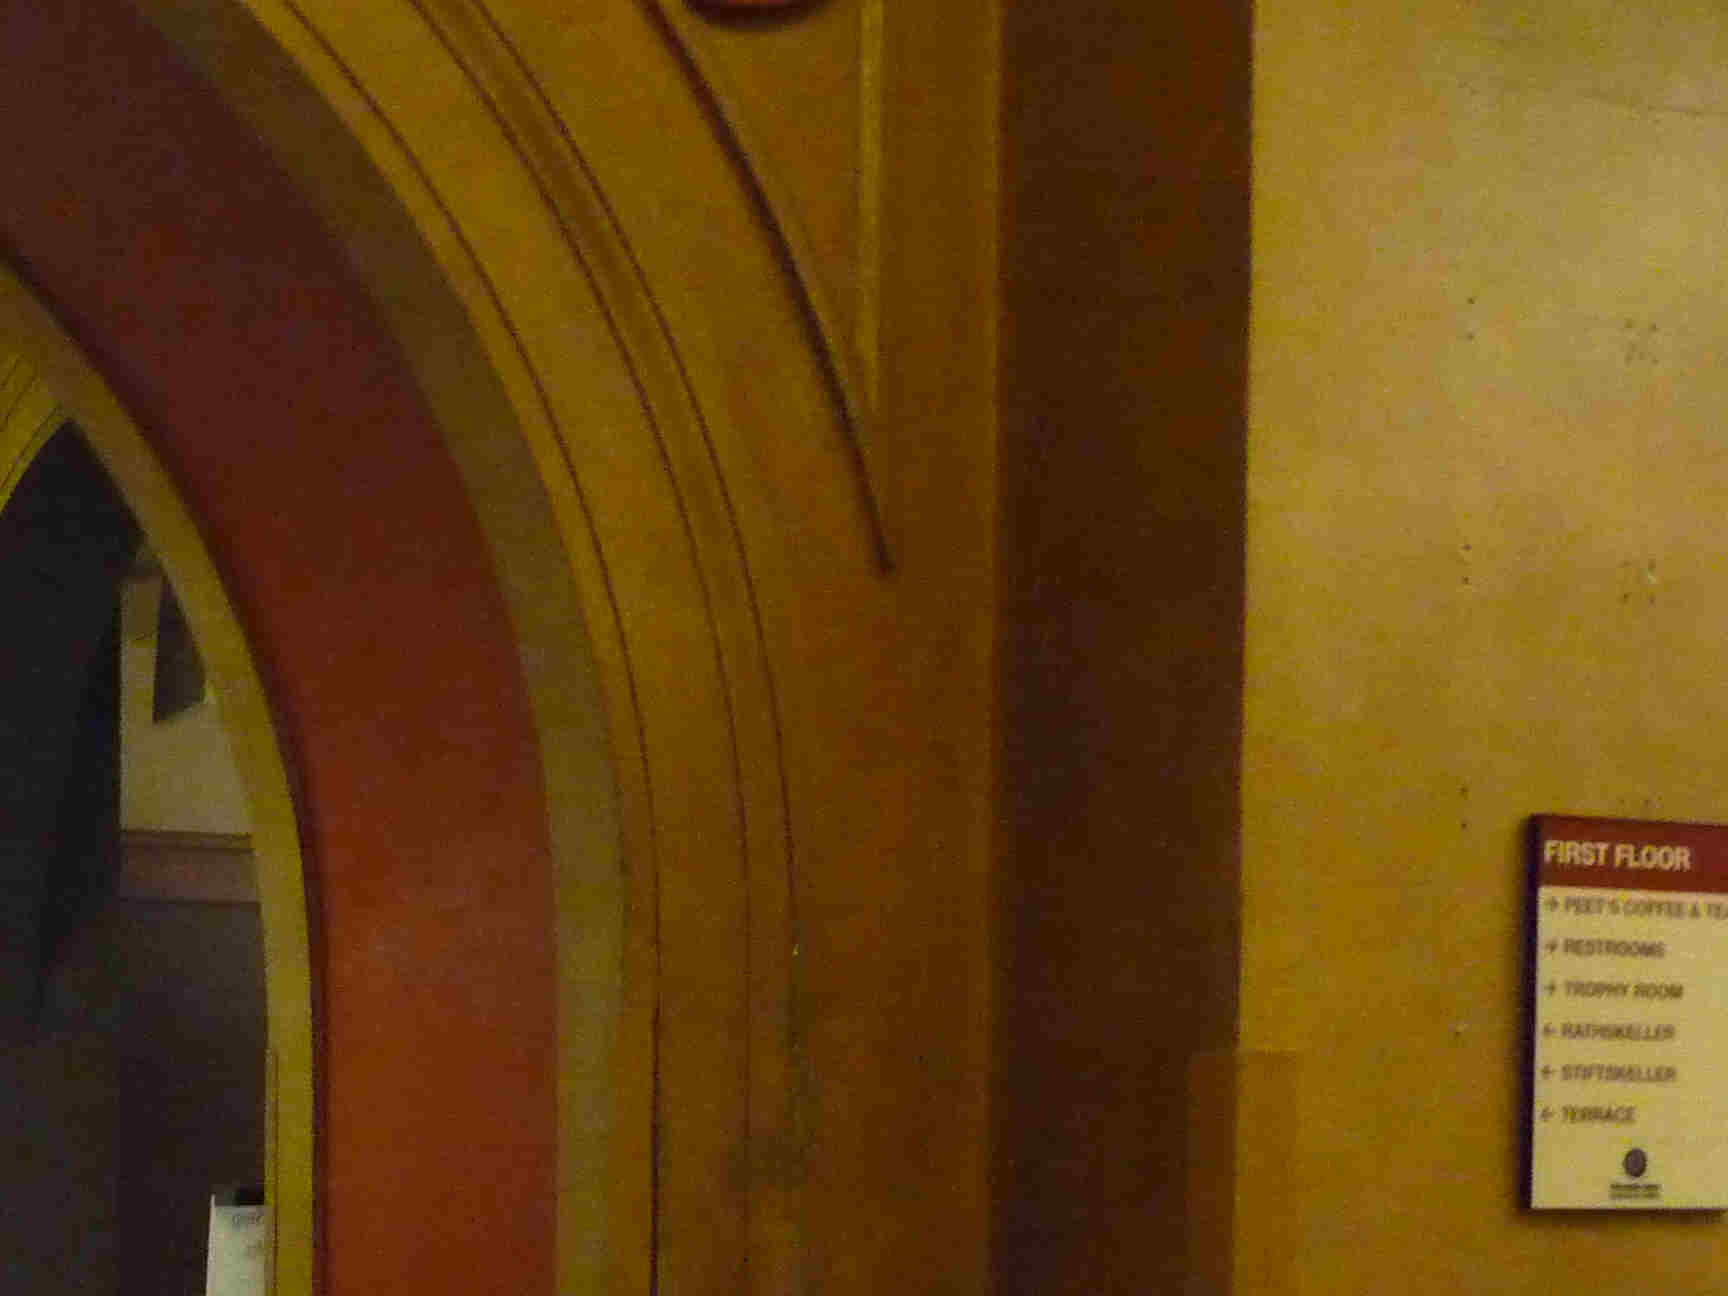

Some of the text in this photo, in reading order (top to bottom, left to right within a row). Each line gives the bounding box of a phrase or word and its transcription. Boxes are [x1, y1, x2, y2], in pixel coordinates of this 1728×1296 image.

[1544, 840, 1690, 872] FIRST FLOOR
[1563, 938, 1666, 957] RESTROOMS
[1633, 983, 1684, 999] ROOM
[1561, 1106, 1636, 1124] TERRACE
